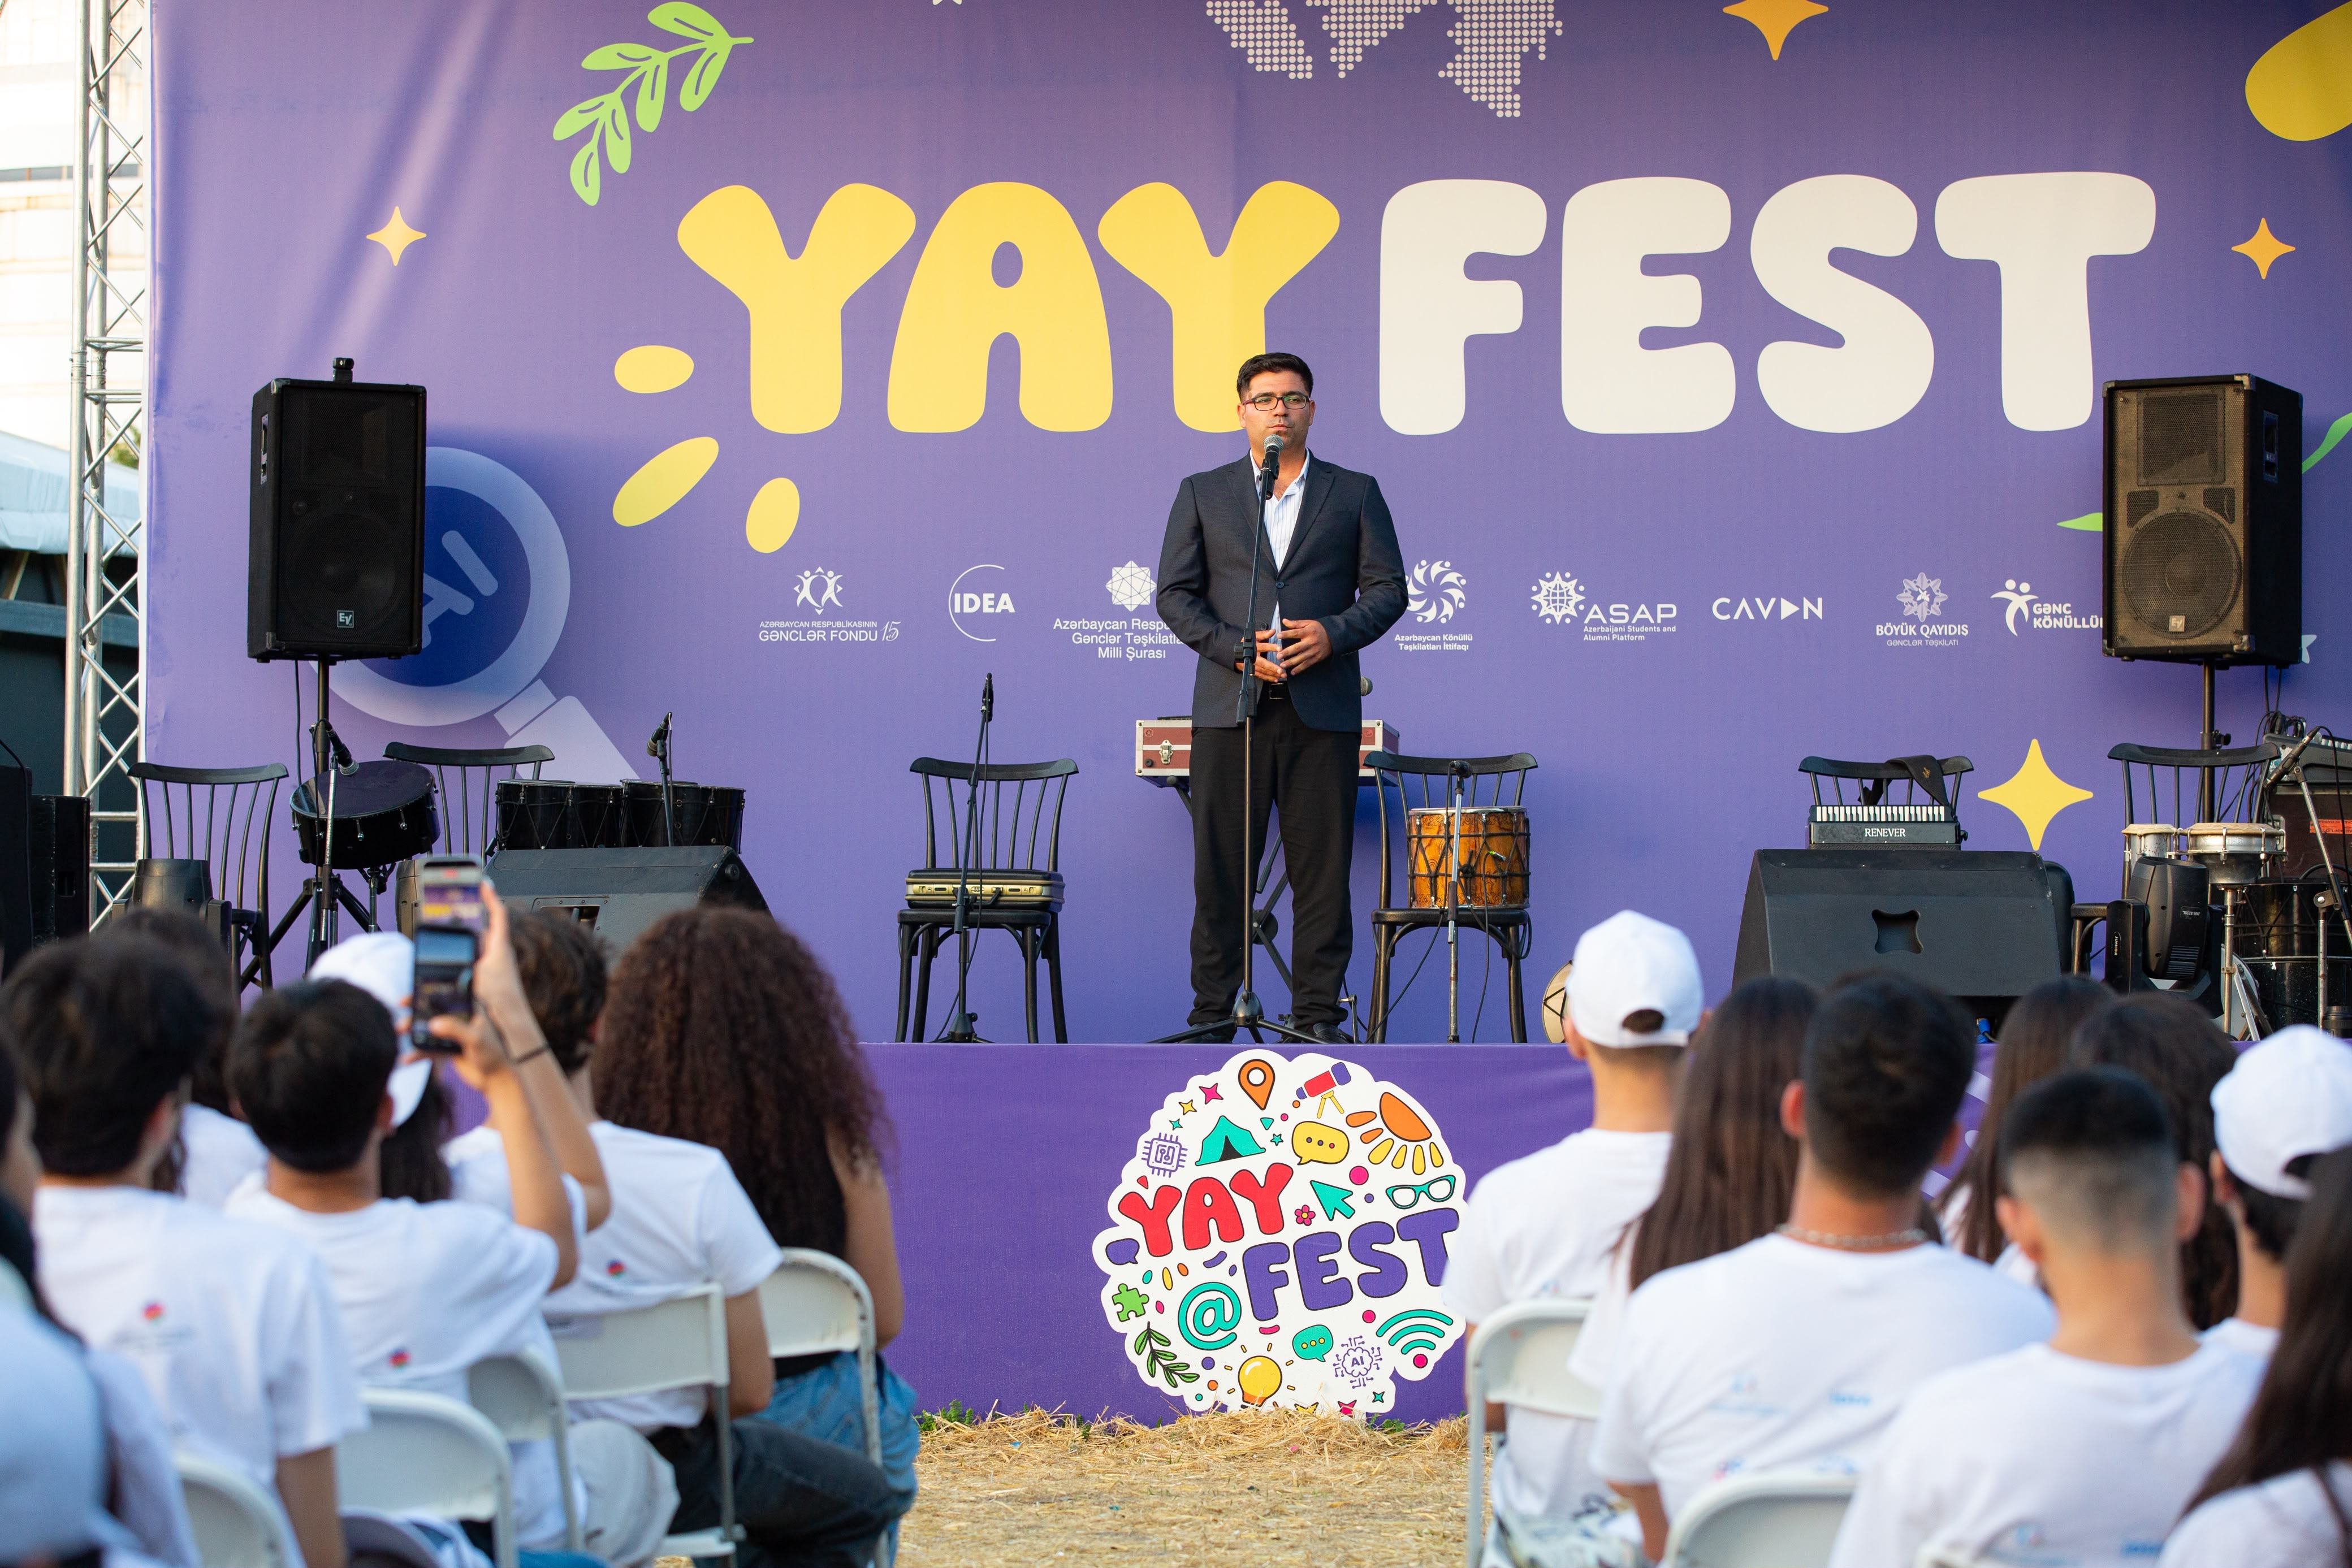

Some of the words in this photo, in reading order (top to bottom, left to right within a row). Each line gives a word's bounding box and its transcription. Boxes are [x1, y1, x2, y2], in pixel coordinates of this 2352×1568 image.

[677, 180, 1340, 434] YAY
[1380, 171, 2156, 435] FEST
[954, 593, 1015, 613] IDEA
[2033, 603, 2072, 615] GƏNC
[1584, 604, 1677, 624] ASAP
[1053, 618, 1127, 632] Azərbaycan
[1584, 625, 1625, 634] Azerbaijani
[1876, 622, 1917, 636] BÖYÜK
[1920, 624, 1969, 638] QAYIDIŞ
[759, 630, 826, 641] GƏNCLƏR
[831, 630, 877, 642] FONDU
[1072, 633, 1121, 644] Gənclər
[1443, 642, 1469, 651] İttifaqı
[1099, 647, 1122, 659] Milli
[1126, 647, 1166, 661] Şurası
[1865, 828, 1906, 837] RENEVER
[1118, 1163, 1294, 1258] YAY
[1242, 1207, 1460, 1322] FEST
[1351, 1356, 1364, 1367] AI
